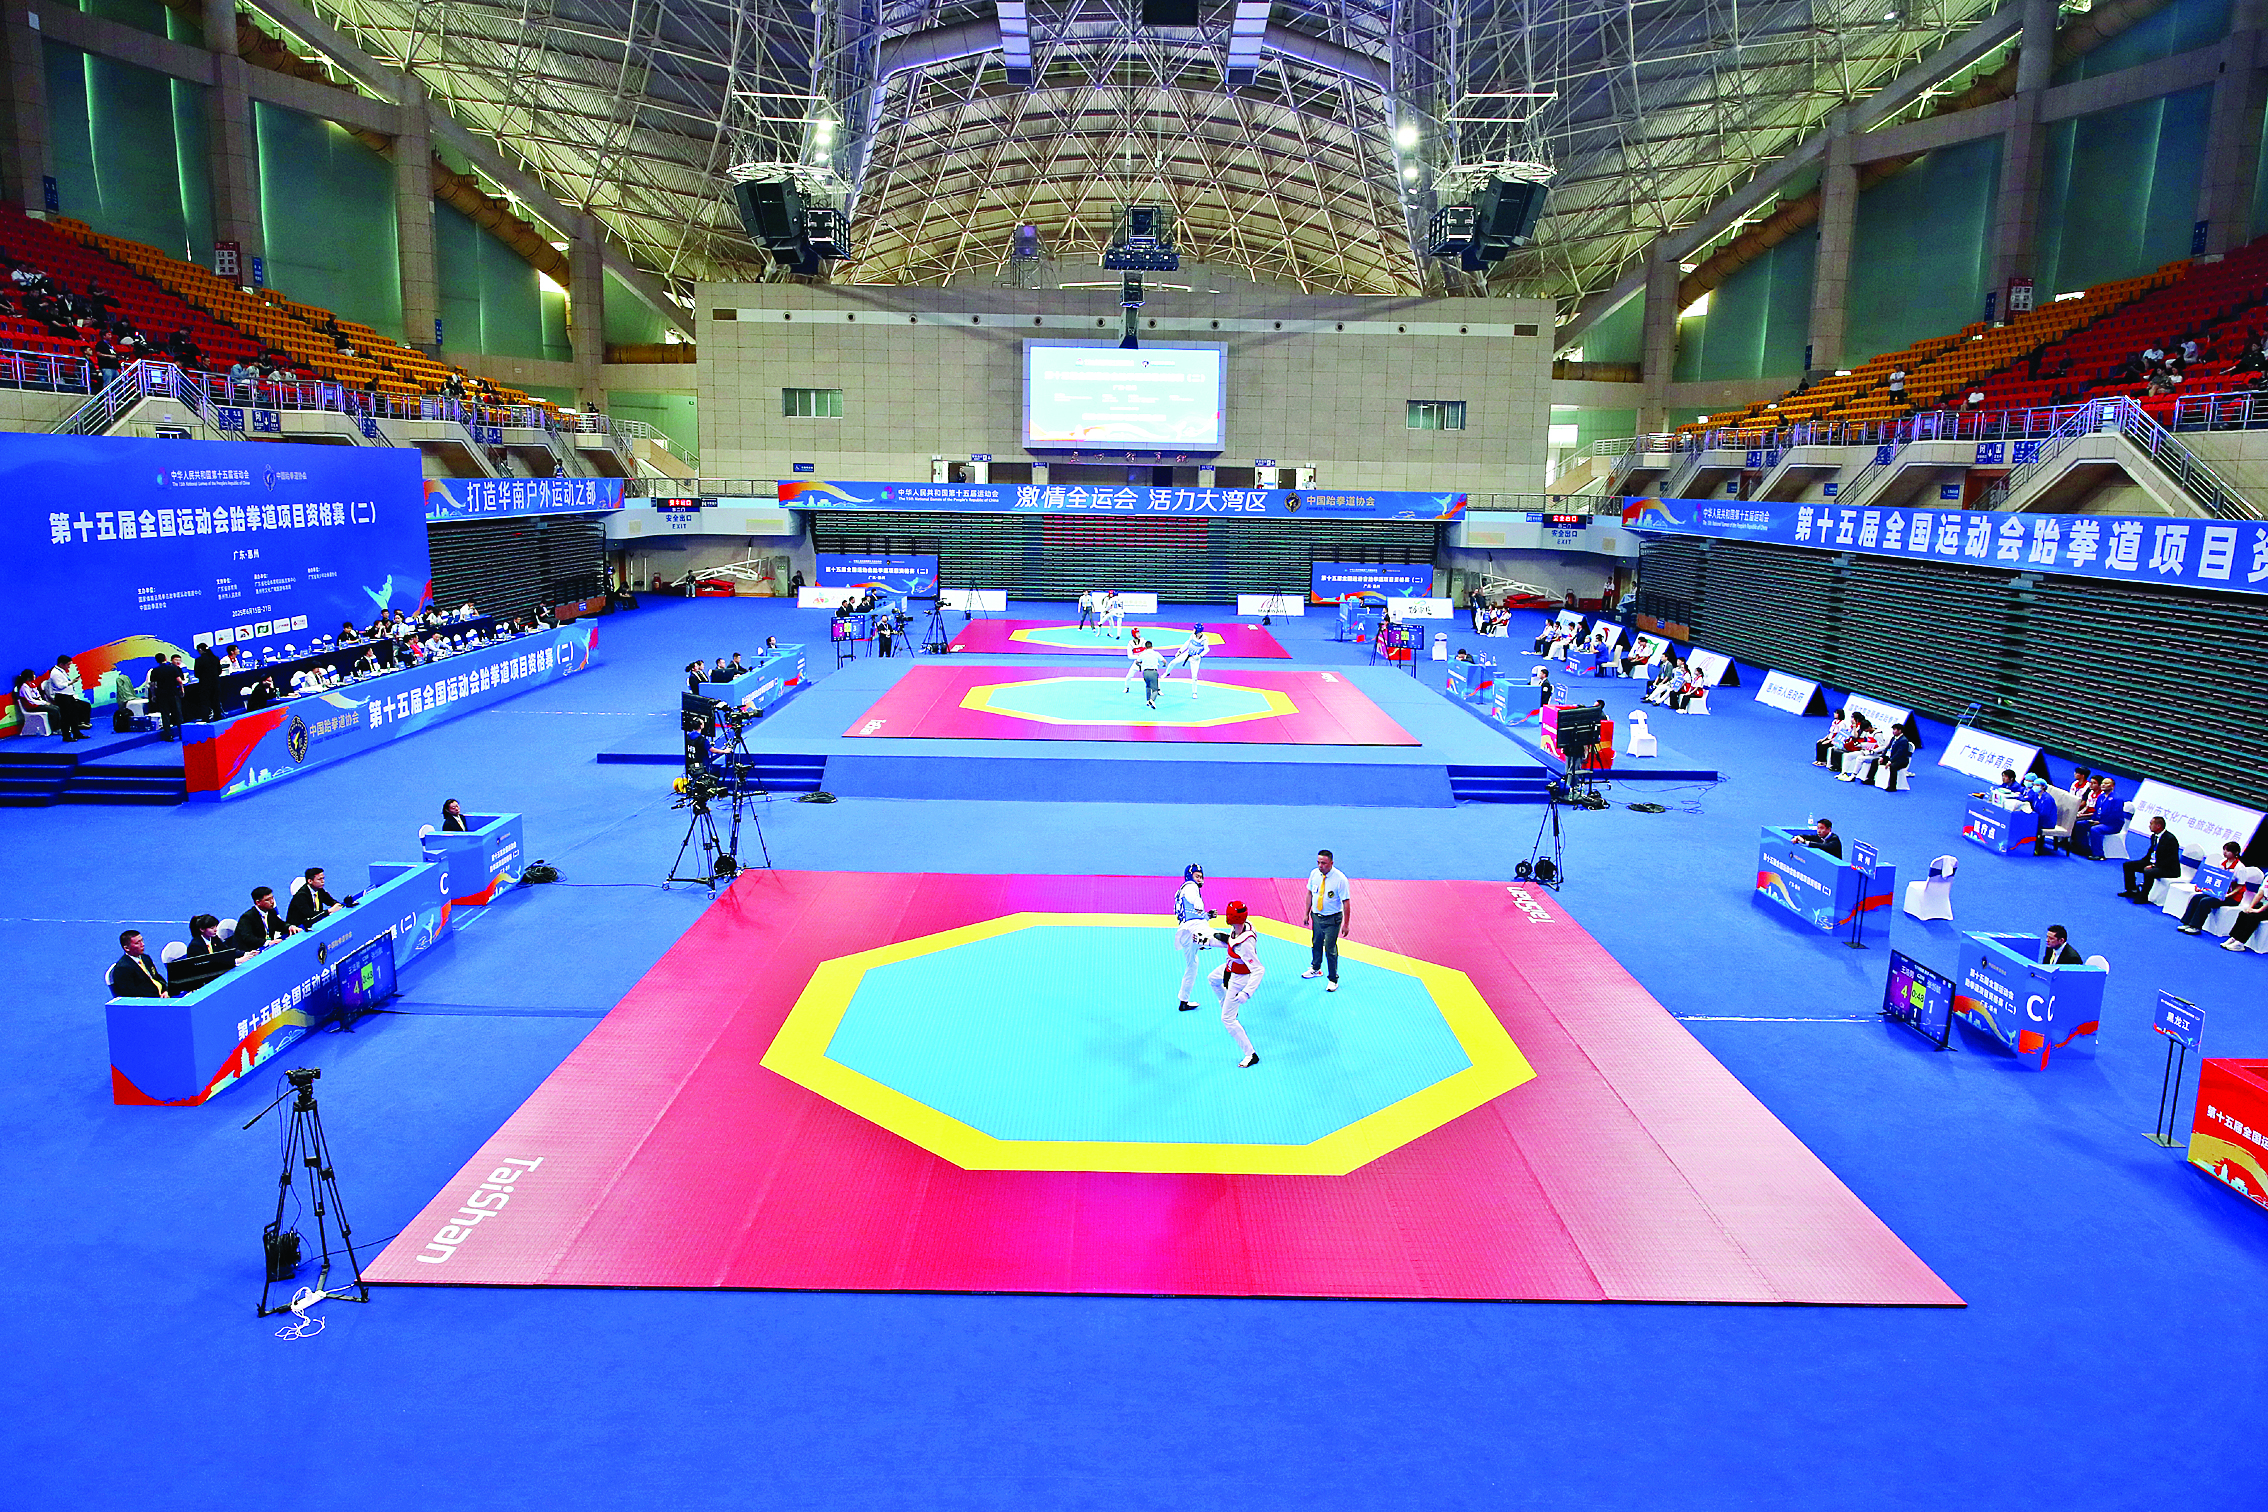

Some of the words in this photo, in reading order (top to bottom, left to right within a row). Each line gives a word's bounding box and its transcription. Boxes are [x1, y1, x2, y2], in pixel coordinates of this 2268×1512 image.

[467, 480, 596, 513] 打造华南户外运动之都
[898, 488, 998, 498] 中华人民共和国第十五届运动会
[1014, 486, 1139, 511] 激情全运会
[1147, 488, 1267, 512] 活力大湾区
[1307, 496, 1375, 506] 中国跆拳道协会
[49, 502, 376, 544] 第十五届全国运动会跆拳道项目资格赛（二）
[1704, 508, 1769, 522] 中华人民共和国第十五届运动会
[1552, 530, 1578, 538] 安全出口
[368, 641, 574, 729] 第十五届全国运动会跆拳道项目资格赛（二）
[310, 711, 359, 738] 中国跆拳道协会
[1960, 744, 2014, 770] 广东省体育局
[2136, 800, 2242, 842] 惠州市文化广电旅游体育局
[440, 872, 449, 894] C
[377, 966, 381, 979] 1
[354, 980, 360, 994] 4
[368, 990, 372, 999] 1
[1901, 985, 1908, 998] 4
[1912, 990, 1924, 1002] 0:48
[1914, 1008, 1918, 1018] 1
[1929, 1000, 1934, 1014] 1
[2026, 995, 2044, 1022] C
[2166, 1012, 2190, 1032] 黑龙江
[416, 1156, 544, 1264] TaiShan
